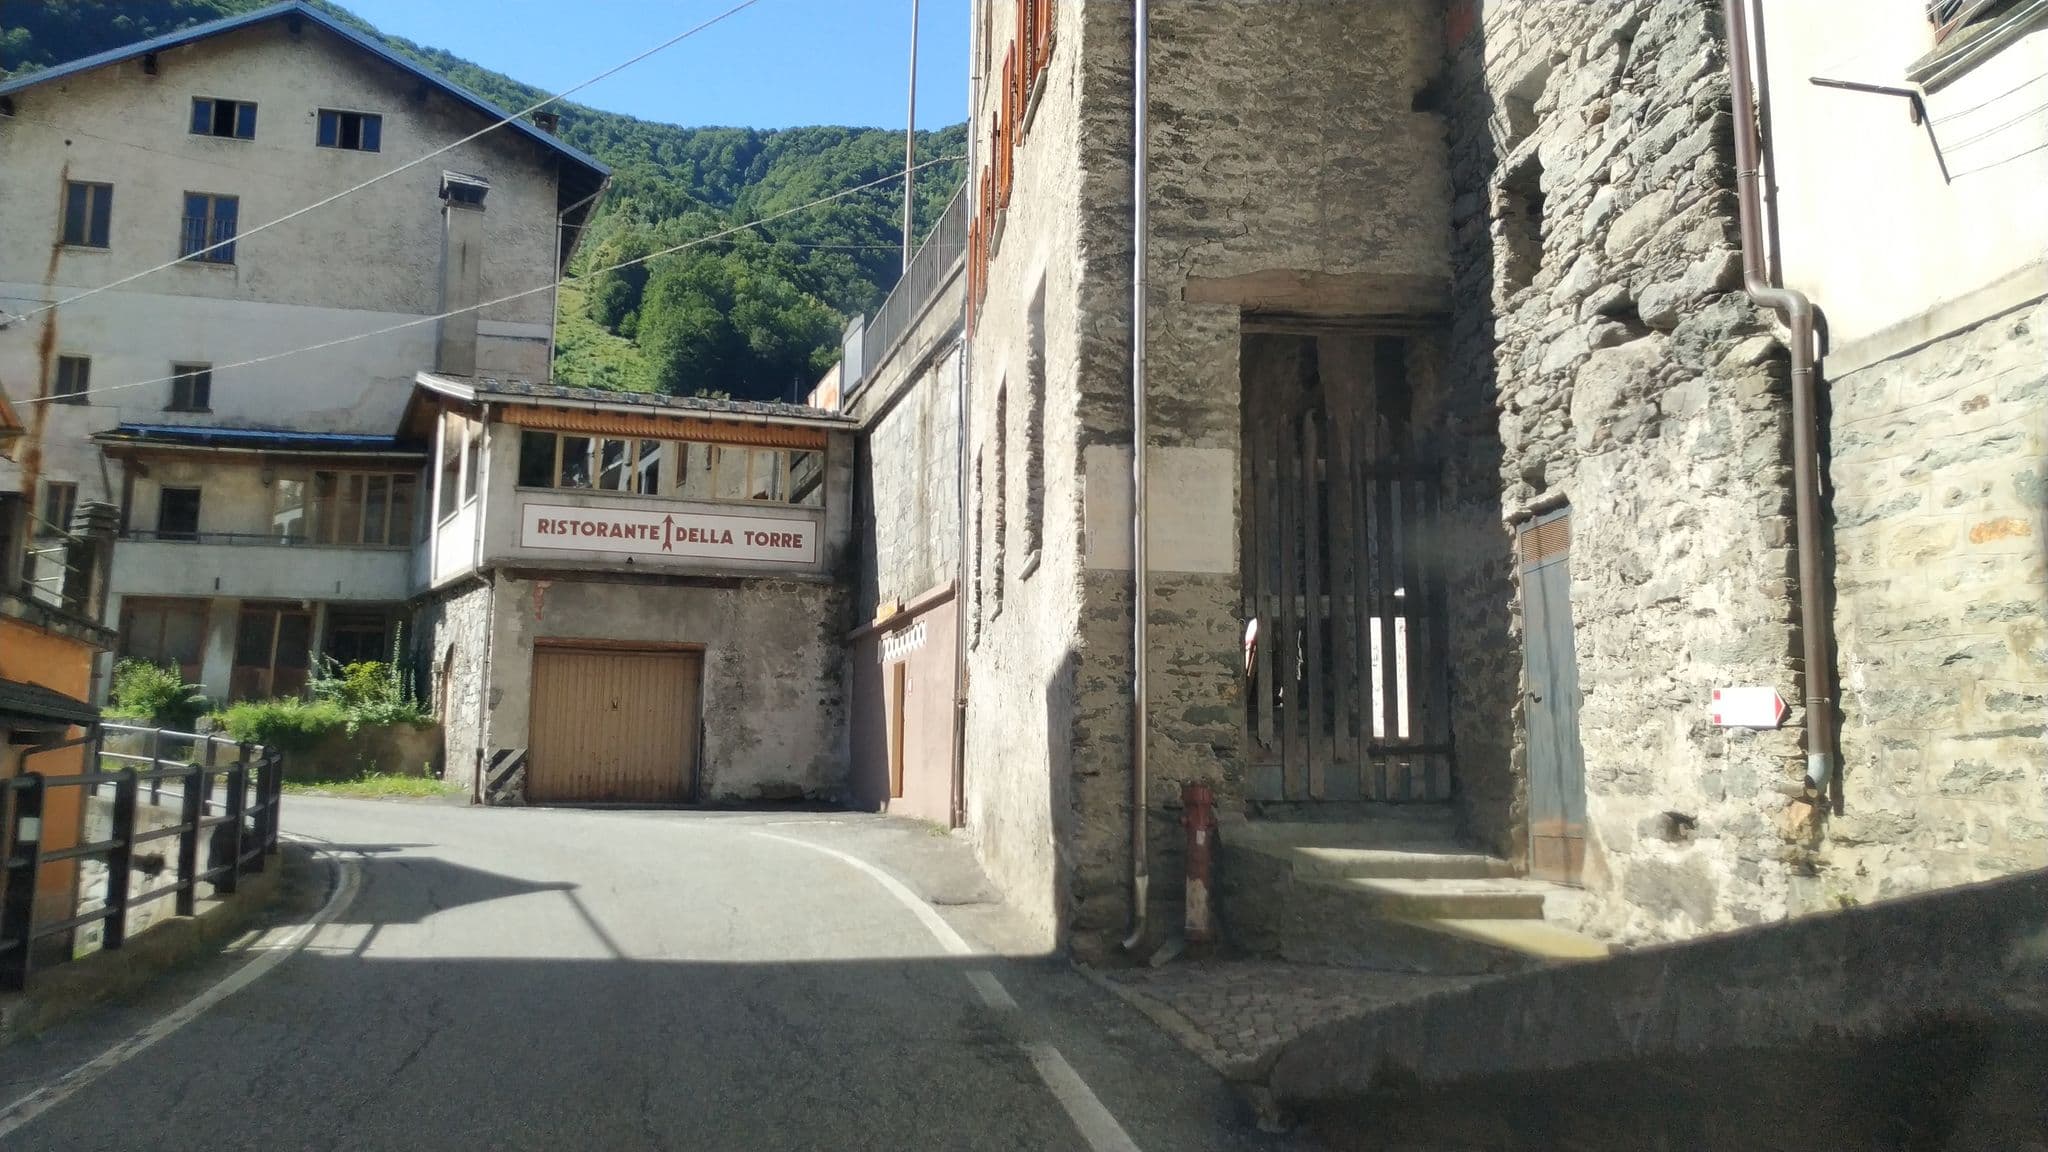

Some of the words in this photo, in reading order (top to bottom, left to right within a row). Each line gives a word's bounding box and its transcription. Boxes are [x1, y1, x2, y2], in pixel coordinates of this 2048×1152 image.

[538, 518, 660, 541] RISTORANTE
[676, 527, 733, 545] DELLA
[744, 530, 803, 549] TORRE
